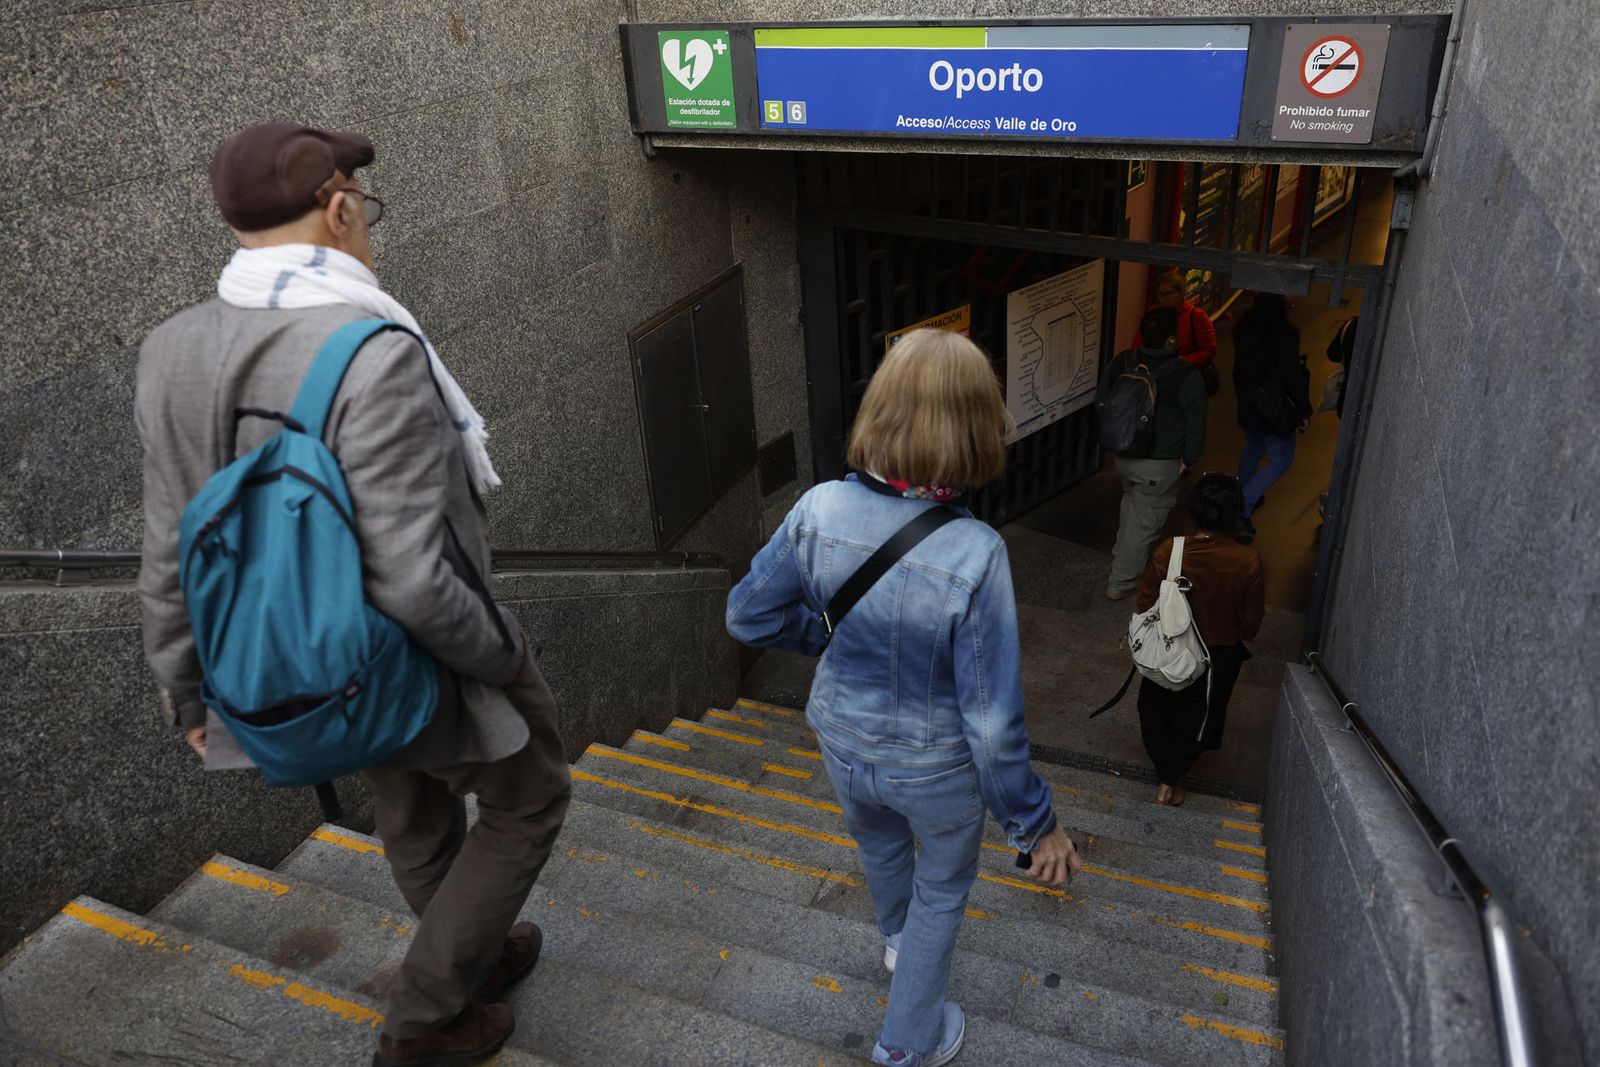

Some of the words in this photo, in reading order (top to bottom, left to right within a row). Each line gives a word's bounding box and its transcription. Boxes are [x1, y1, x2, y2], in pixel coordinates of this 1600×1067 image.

[928, 60, 1043, 99] Oporto
[668, 96, 697, 106] Estación
[697, 97, 721, 106] dotada
[721, 98, 731, 107] de
[679, 107, 721, 116] desfibrilador
[769, 103, 779, 120] 5
[791, 103, 802, 121] 6
[1279, 105, 1334, 117] Prohibido
[1336, 106, 1371, 118] fumar
[896, 115, 991, 130] Acceso/Access
[994, 116, 1027, 131] Valle
[1030, 117, 1047, 131] de
[1051, 118, 1077, 132] Oro
[1289, 119, 1306, 130] No
[1307, 121, 1354, 134] smoking
